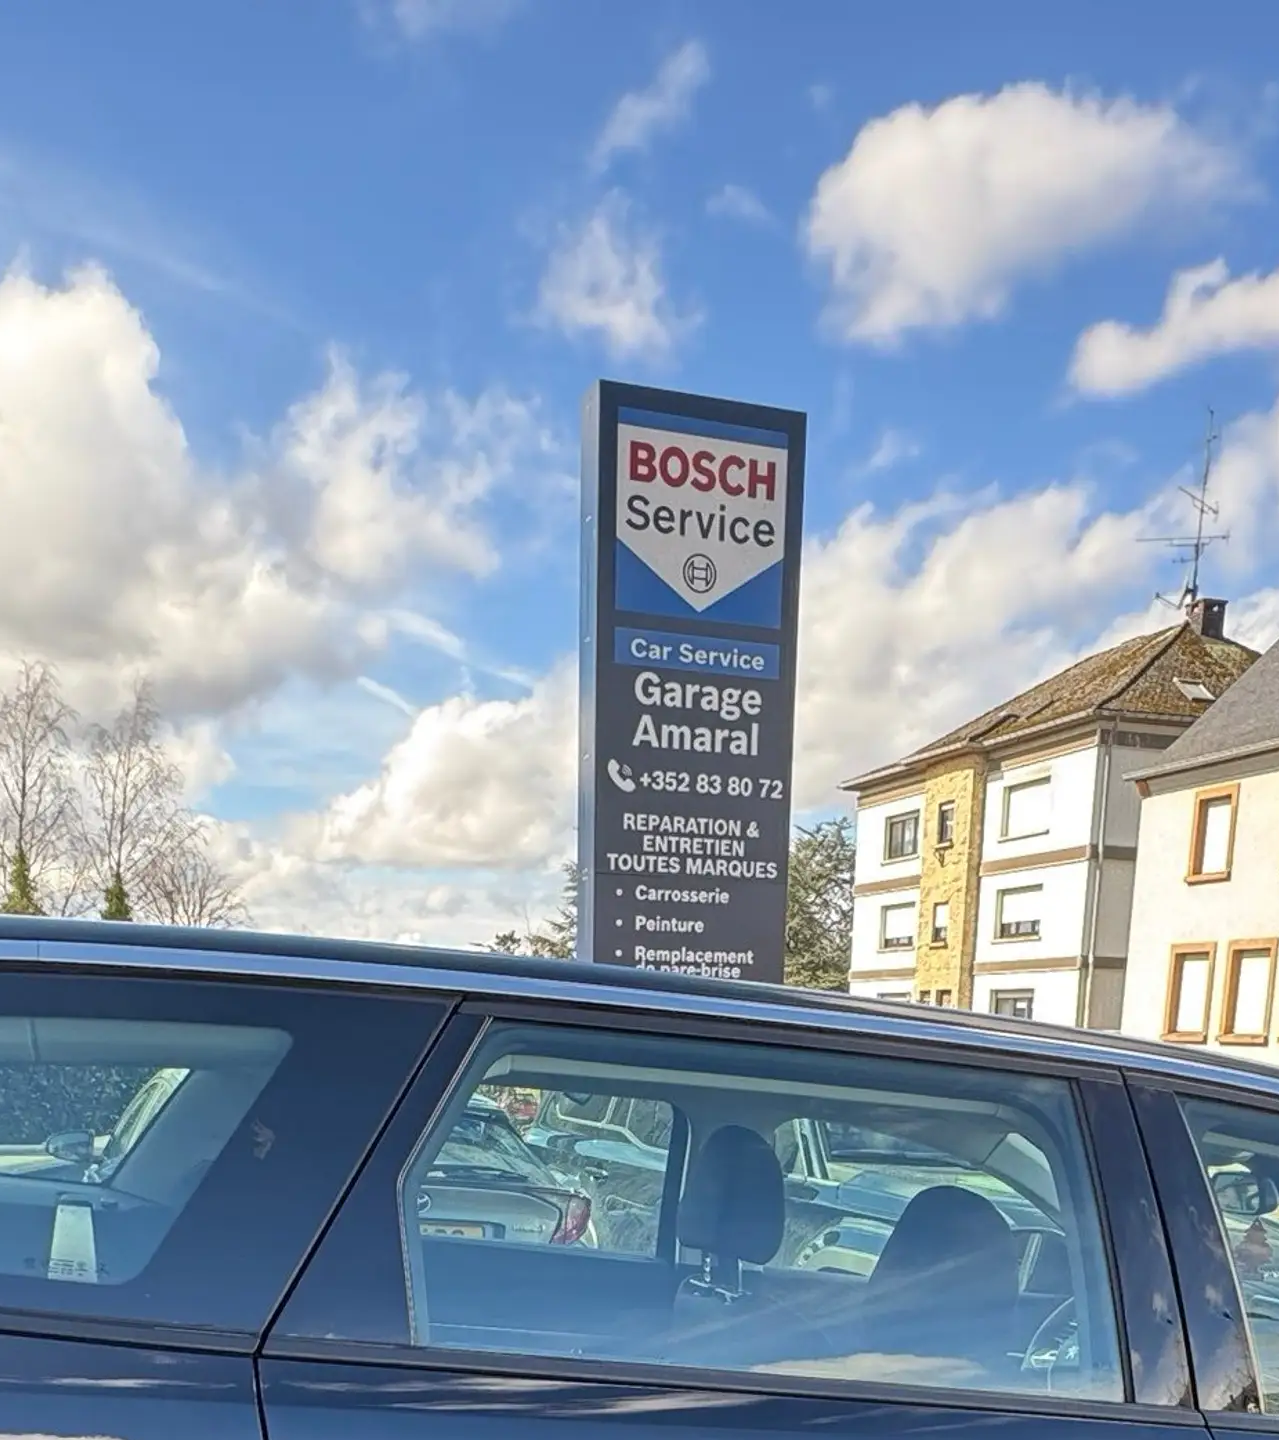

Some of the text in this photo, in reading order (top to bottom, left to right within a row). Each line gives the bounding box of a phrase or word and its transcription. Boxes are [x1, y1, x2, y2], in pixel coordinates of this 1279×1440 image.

[629, 440, 776, 501] BOSCH
[625, 494, 775, 548] Service
[630, 638, 765, 671] Car Service
[634, 671, 763, 721] Garage
[632, 714, 760, 756] Amaral
[639, 770, 783, 799] +352 83 80 72
[623, 813, 760, 838] REPARATION &
[642, 835, 745, 857] ENTRETIEN
[607, 853, 778, 879] TOUTES MARQUES
[635, 884, 730, 904] Carrosserie
[635, 915, 705, 933] Peinture
[635, 946, 754, 965] Remplacement
